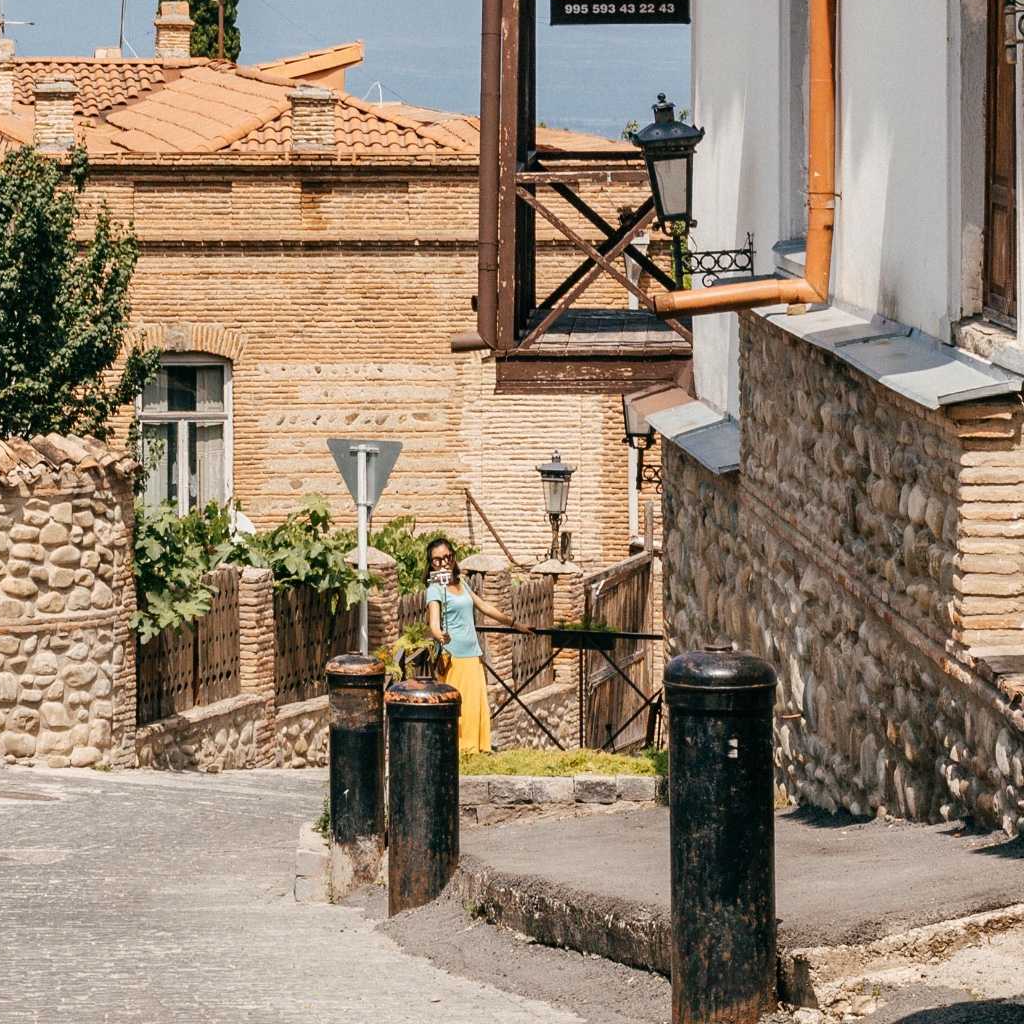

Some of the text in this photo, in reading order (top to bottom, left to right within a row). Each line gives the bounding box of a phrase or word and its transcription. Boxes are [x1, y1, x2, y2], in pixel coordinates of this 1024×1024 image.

[564, 3, 675, 14] 995 593 43 22 43
